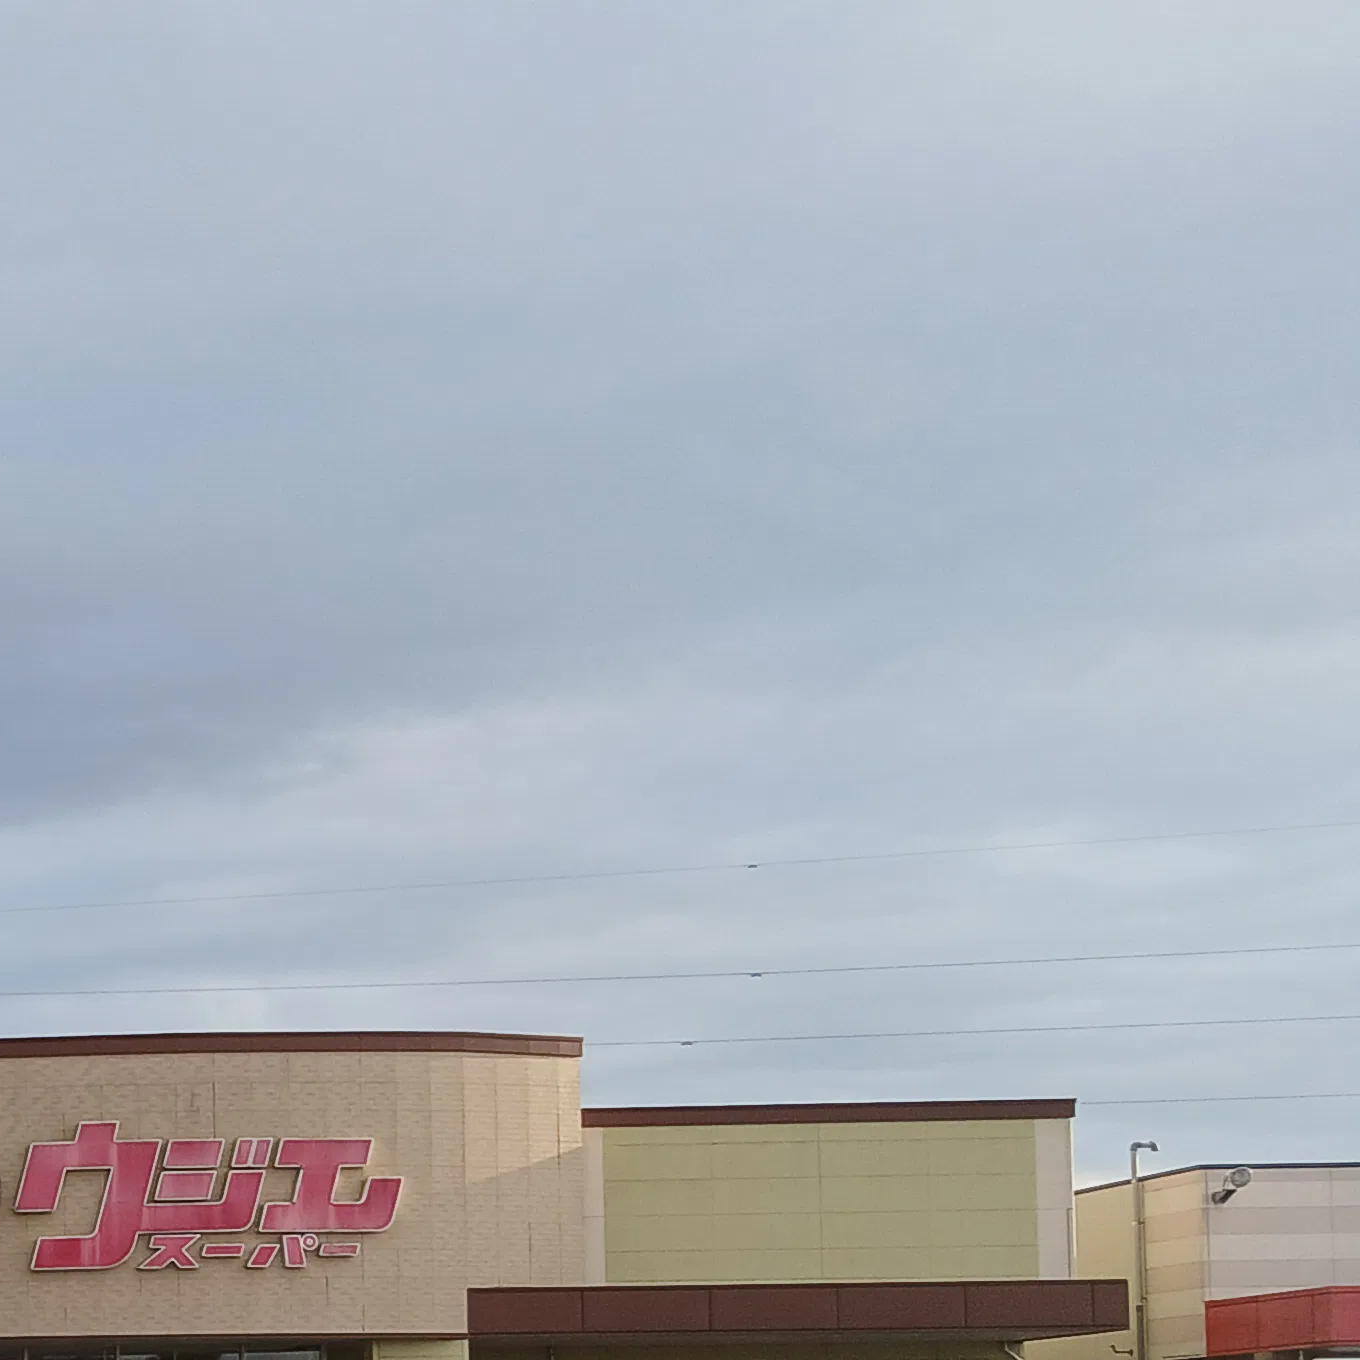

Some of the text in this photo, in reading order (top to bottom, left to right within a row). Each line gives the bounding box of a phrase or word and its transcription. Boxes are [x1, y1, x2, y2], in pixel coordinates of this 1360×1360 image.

[14, 1121, 404, 1271] ウジエ
[136, 1232, 361, 1271] スーパー
